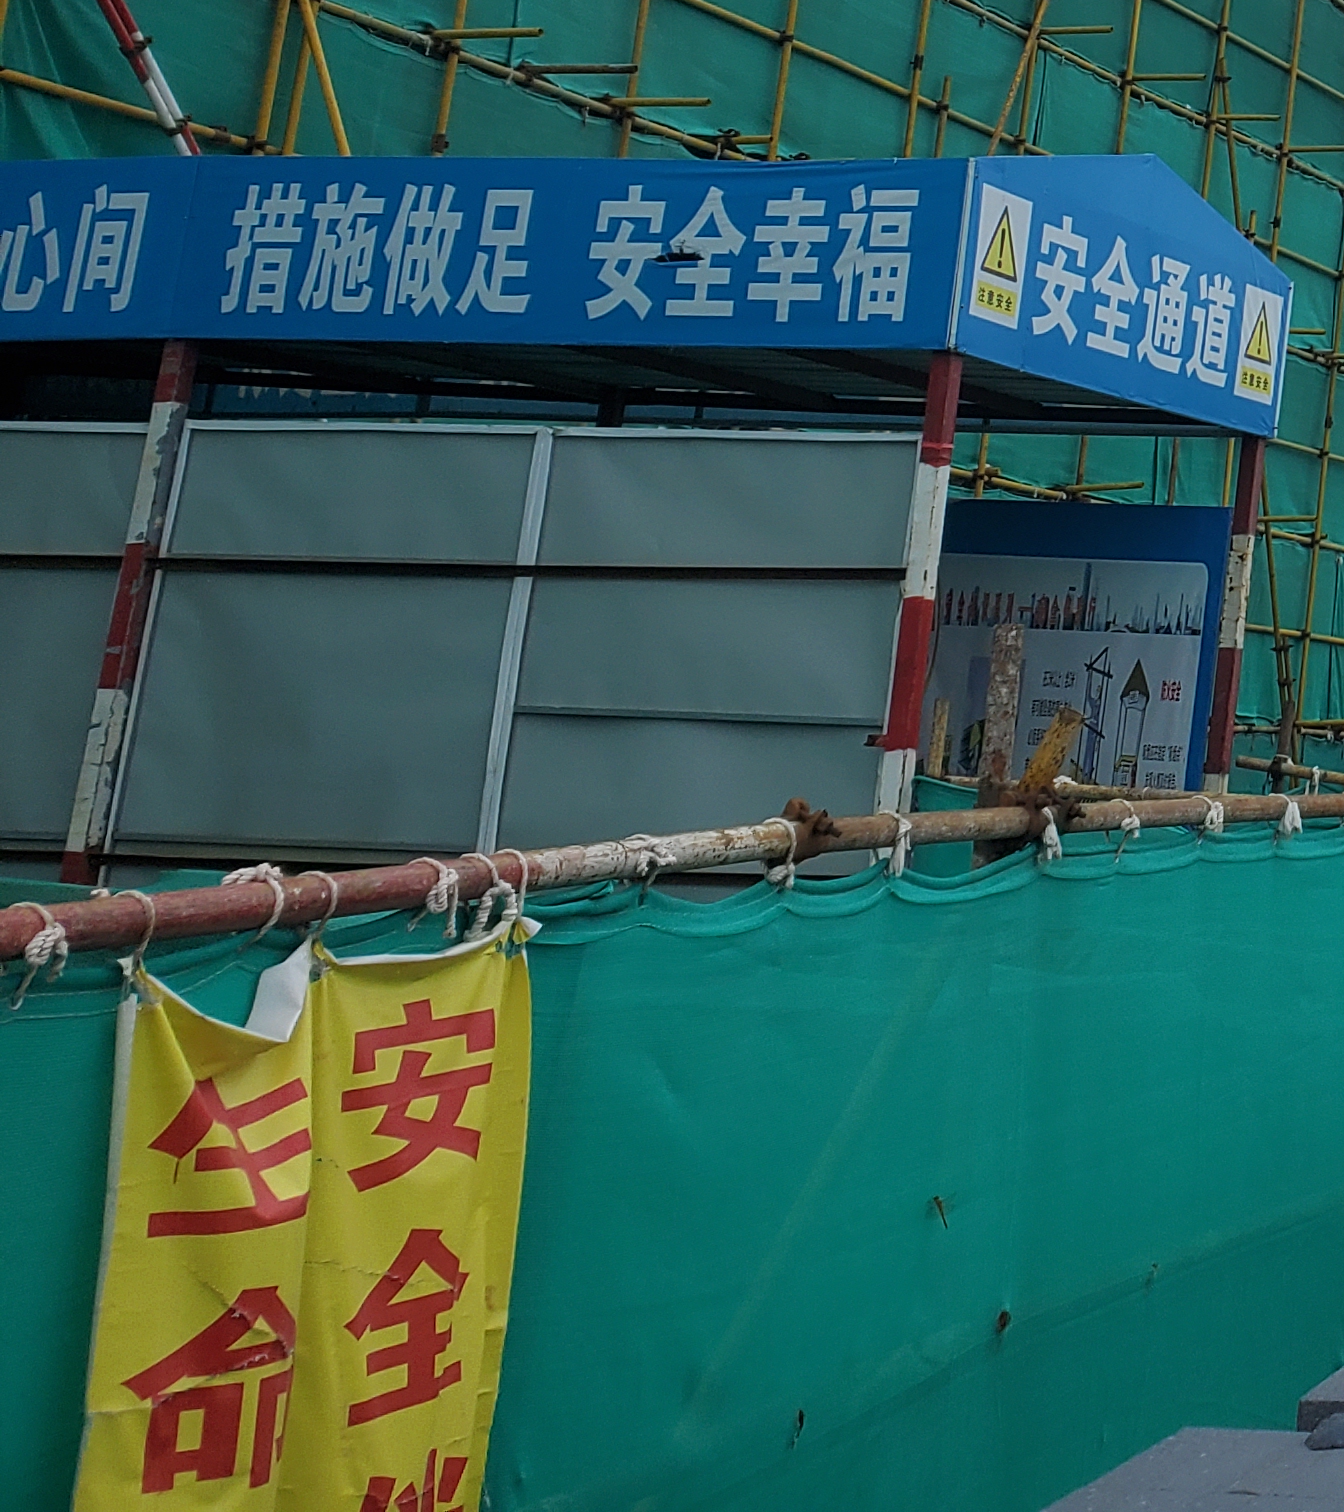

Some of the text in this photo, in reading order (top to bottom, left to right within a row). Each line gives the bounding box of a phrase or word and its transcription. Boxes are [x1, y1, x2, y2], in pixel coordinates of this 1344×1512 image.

[0, 182, 921, 322] 心间 措施做足 安全幸福
[978, 287, 1012, 312] 注意安全
[1031, 215, 1236, 388] 安全通道
